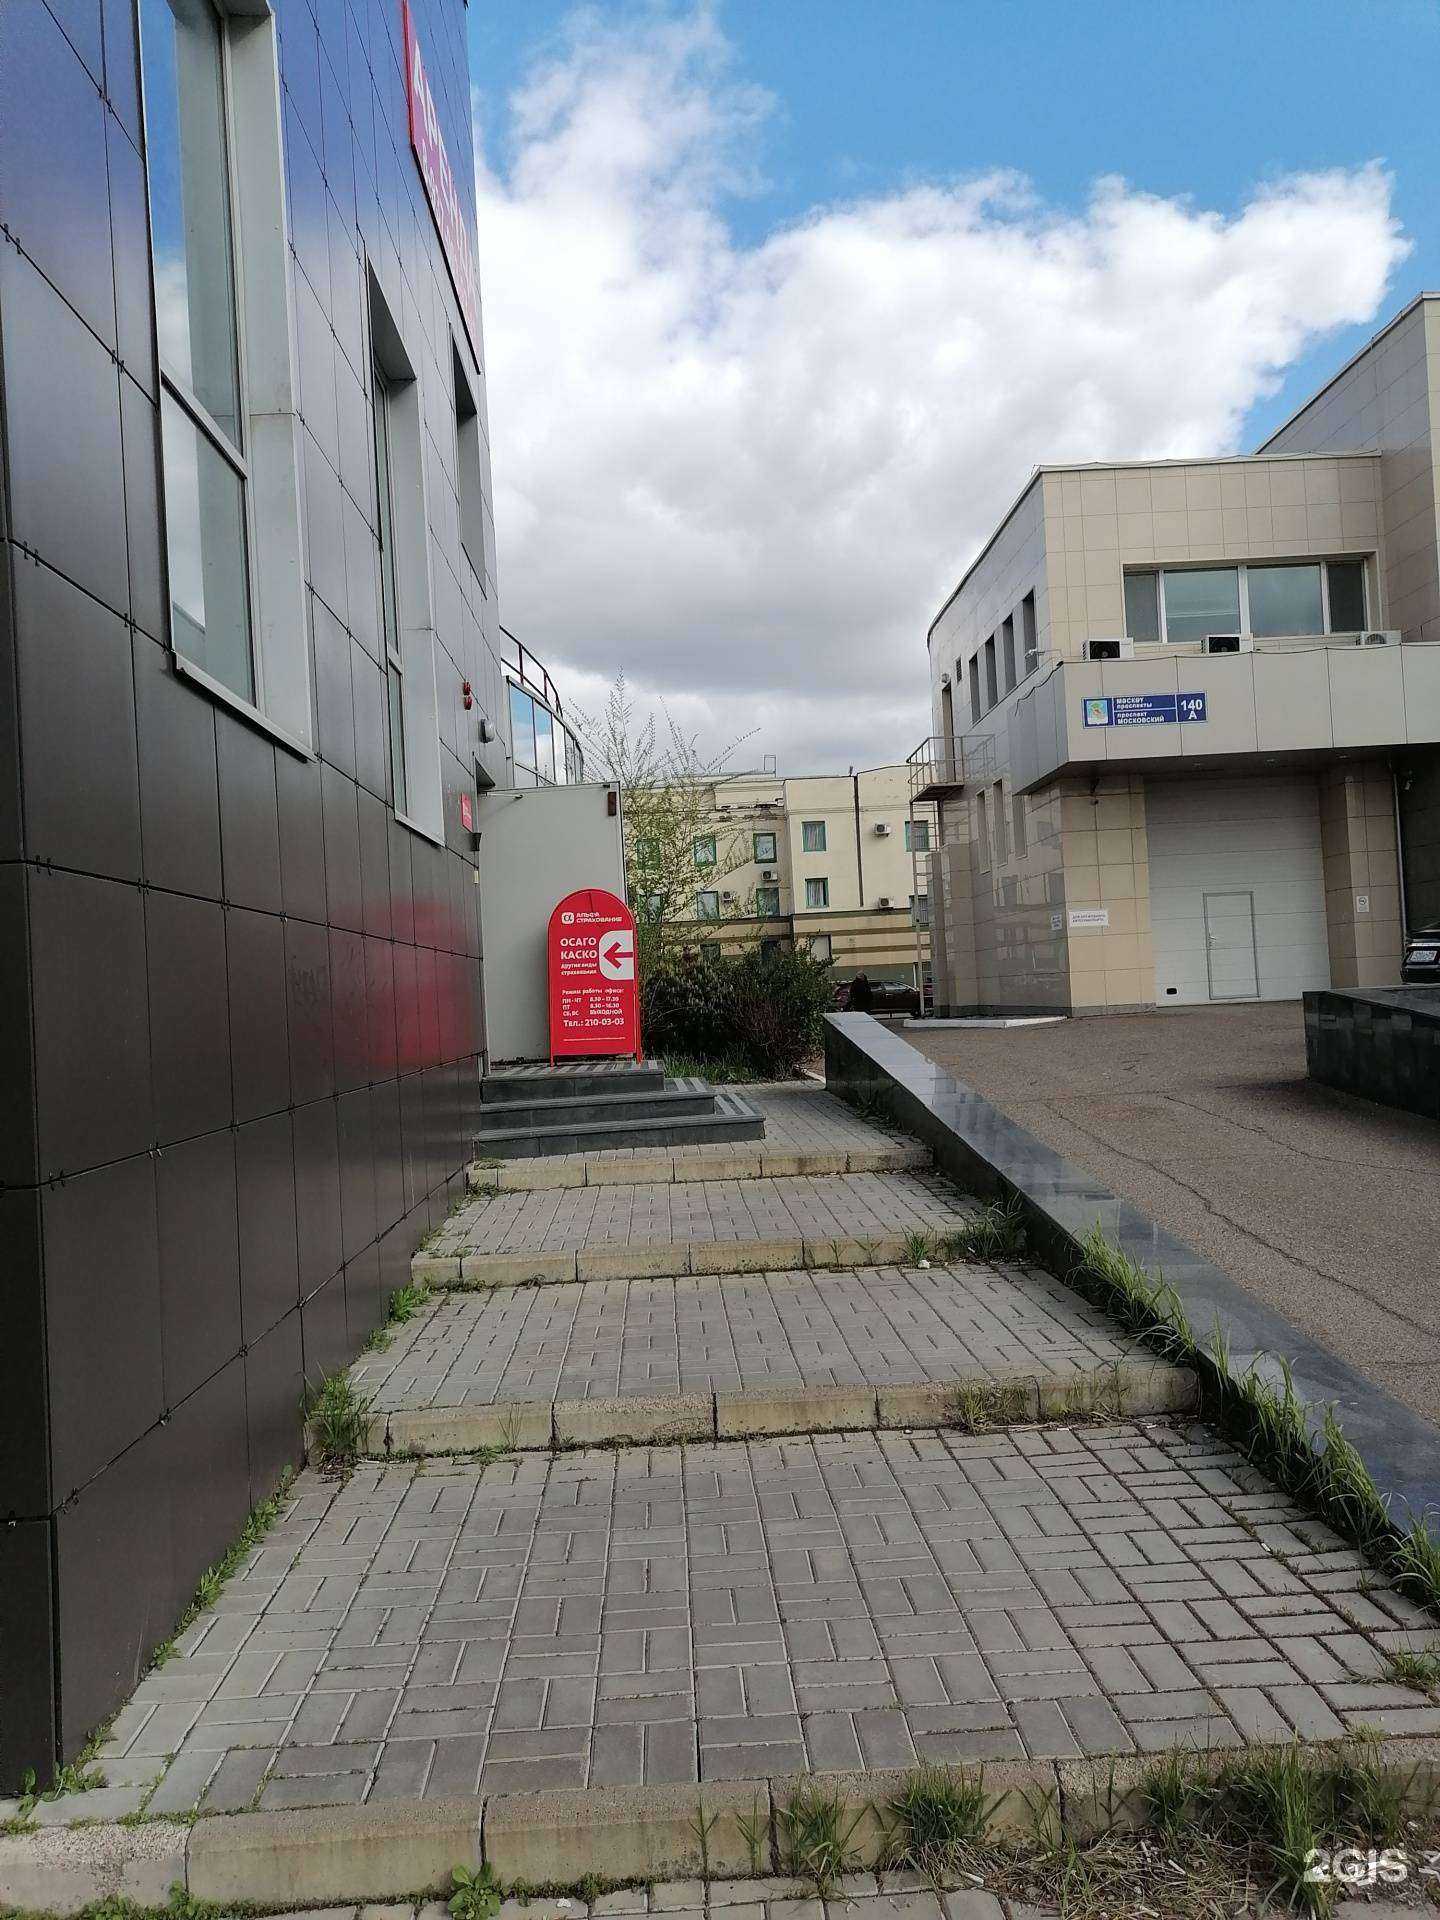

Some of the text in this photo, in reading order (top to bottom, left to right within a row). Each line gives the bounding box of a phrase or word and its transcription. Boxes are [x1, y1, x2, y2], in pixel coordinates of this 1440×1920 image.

[1180, 699, 1203, 711] 140
[1117, 715, 1165, 725] МОСКОВСКИЙ
[560, 937, 597, 947] ОСАГО
[560, 950, 598, 960] КАСКО
[584, 1018, 625, 1027] 210-03-03
